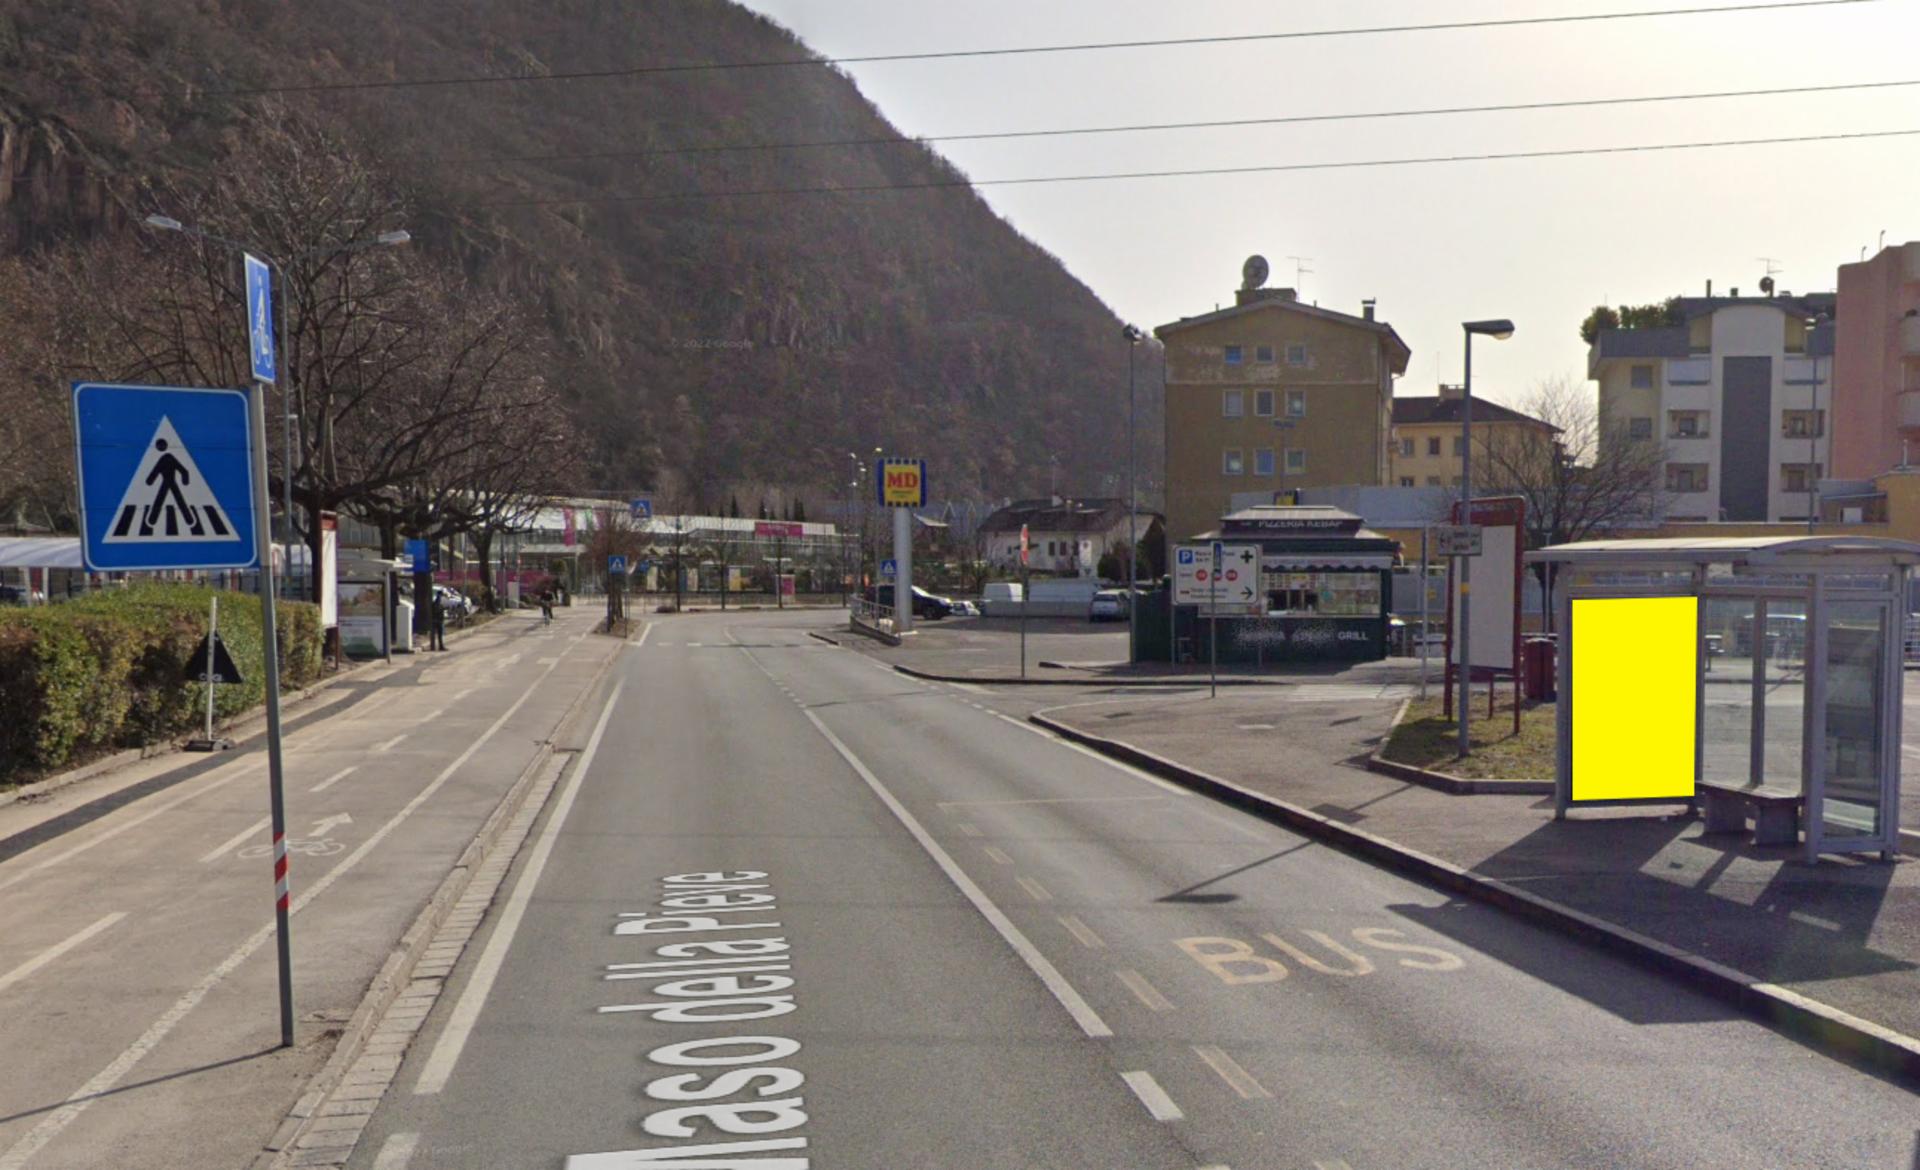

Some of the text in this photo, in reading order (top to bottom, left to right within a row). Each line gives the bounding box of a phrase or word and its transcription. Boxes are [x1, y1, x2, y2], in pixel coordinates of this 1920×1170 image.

[887, 471, 918, 488] MD
[1258, 520, 1304, 528] PIZZERIA
[1337, 631, 1369, 641] GRILL
[1169, 927, 1464, 985] BUS
